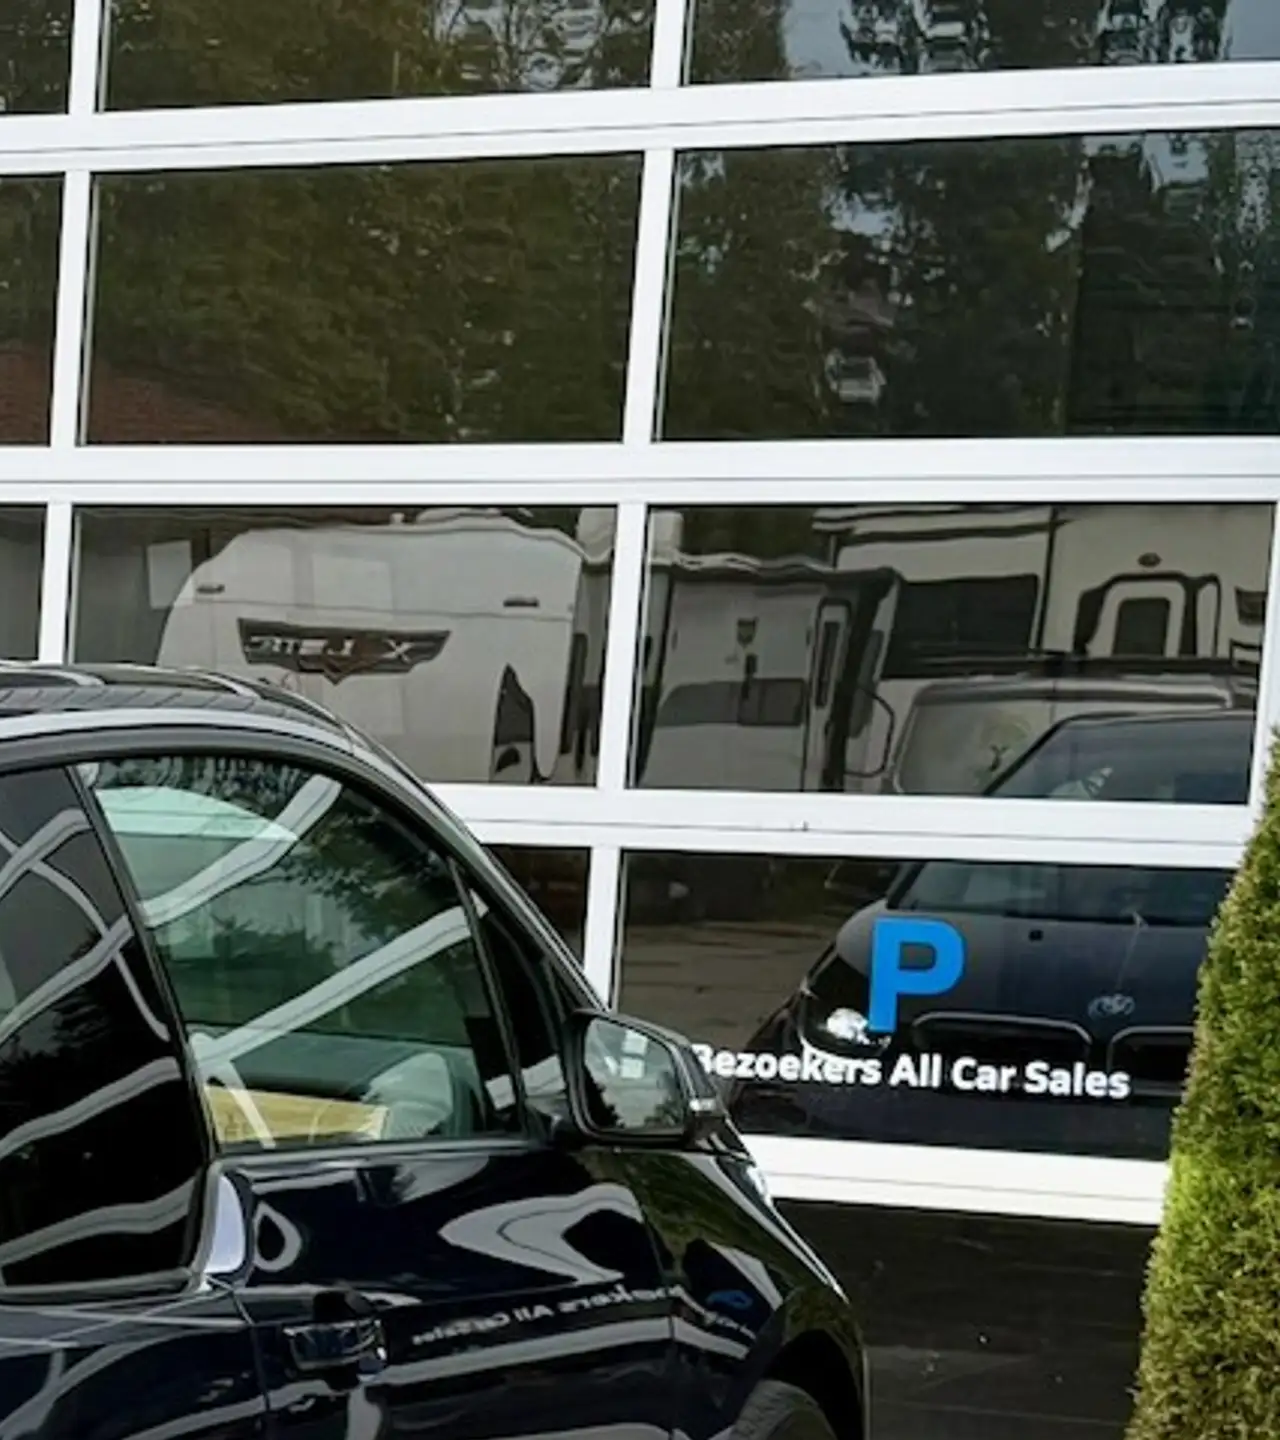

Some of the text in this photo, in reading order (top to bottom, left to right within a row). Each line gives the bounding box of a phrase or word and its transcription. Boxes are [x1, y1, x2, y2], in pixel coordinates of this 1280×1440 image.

[867, 917, 966, 1033] P
[889, 1053, 942, 1088] All
[951, 1056, 1017, 1092] Car
[1023, 1060, 1131, 1099] Sales
